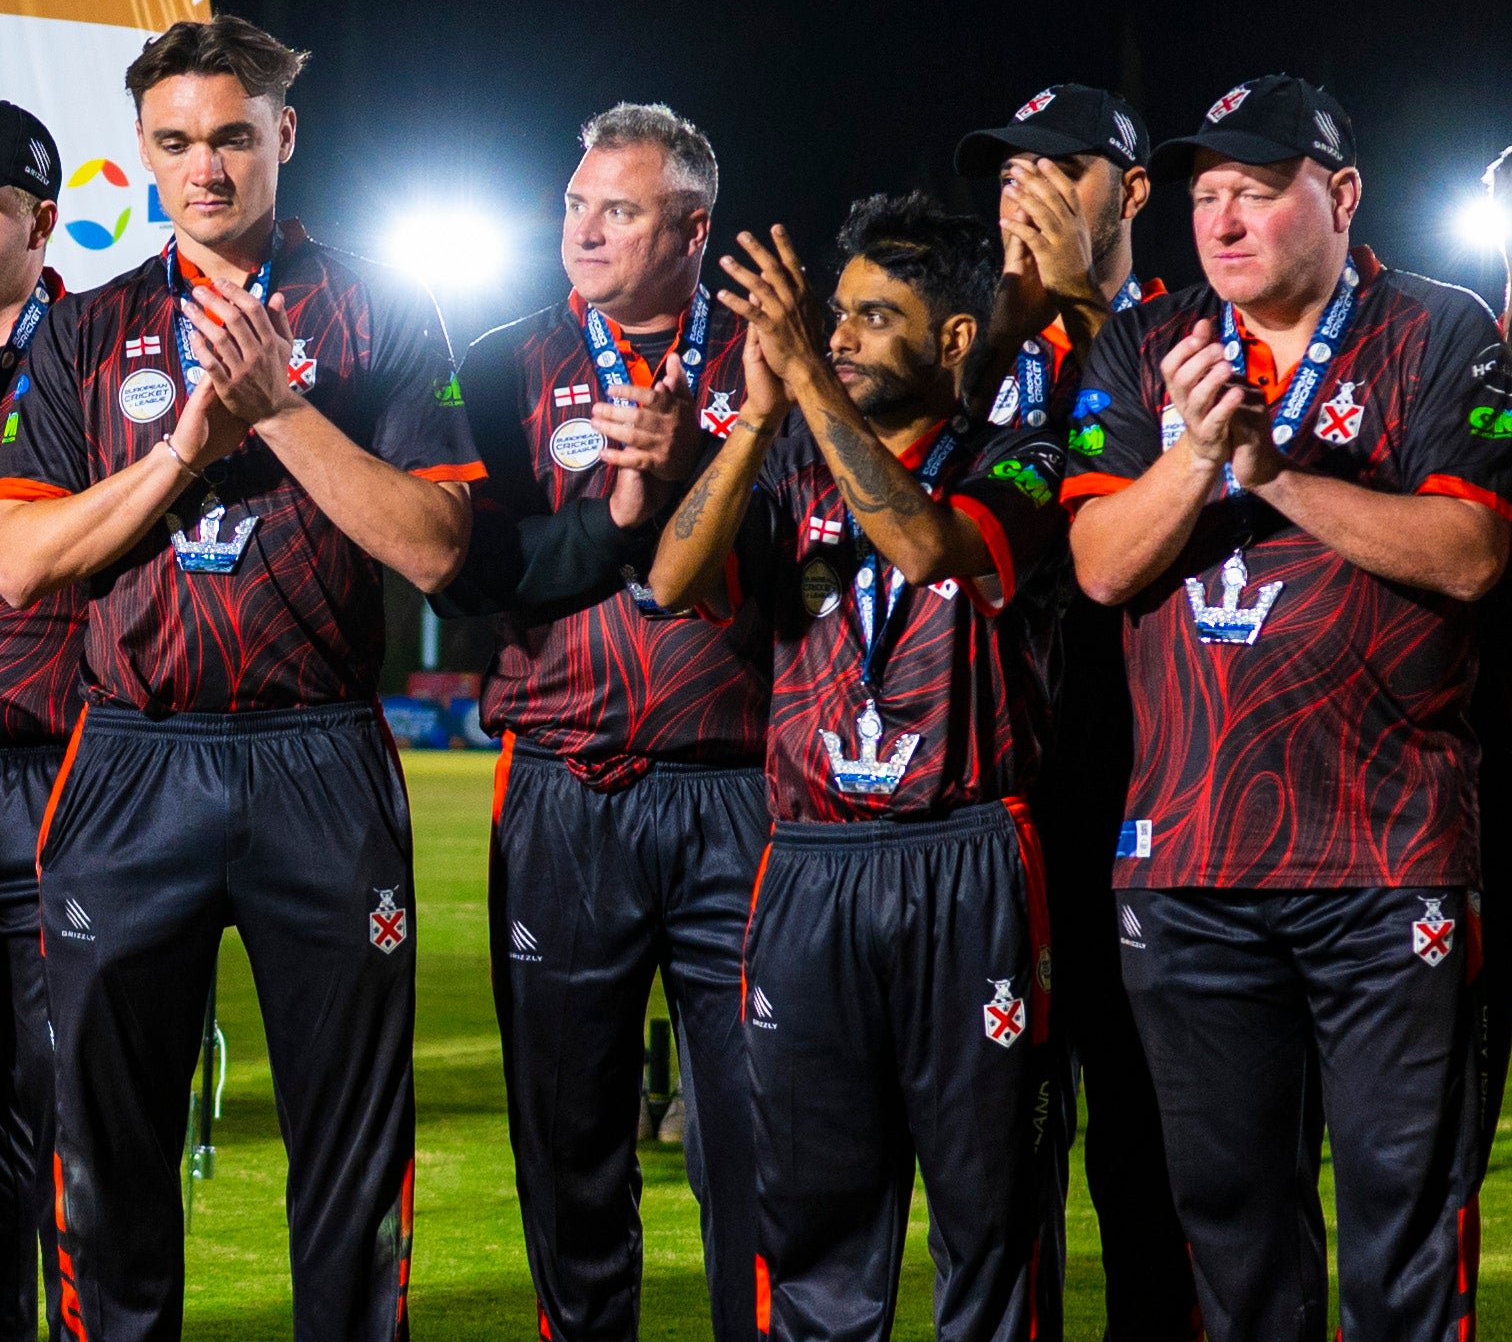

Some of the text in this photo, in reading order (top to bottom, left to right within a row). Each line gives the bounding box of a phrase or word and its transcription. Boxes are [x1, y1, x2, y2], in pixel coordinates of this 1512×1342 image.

[1312, 140, 1344, 163] GRIZZLY
[12, 302, 36, 345] EUROPEAN
[16, 307, 42, 350] CRICKET
[689, 300, 704, 342] EUROPEAN
[698, 306, 710, 345] CRICKET
[1321, 287, 1347, 336] EUROPEAN
[1329, 291, 1352, 339] CRICKET
[124, 383, 168, 396] EUROPEAN
[124, 389, 170, 403] CRICKET
[134, 397, 166, 407] LEAGUE
[1026, 359, 1036, 405] EUROPEAN
[1033, 360, 1044, 404] CRICKET
[1281, 366, 1309, 418] EUROPEAN
[1290, 368, 1319, 420] CRICKET
[556, 432, 601, 444] EUROPEAN
[556, 438, 601, 450] CRICKET
[566, 446, 598, 456] LEAGUE
[922, 433, 951, 477] EUROPEAN
[929, 436, 957, 478] CRICKET
[61, 929, 96, 942] GRIZZLY
